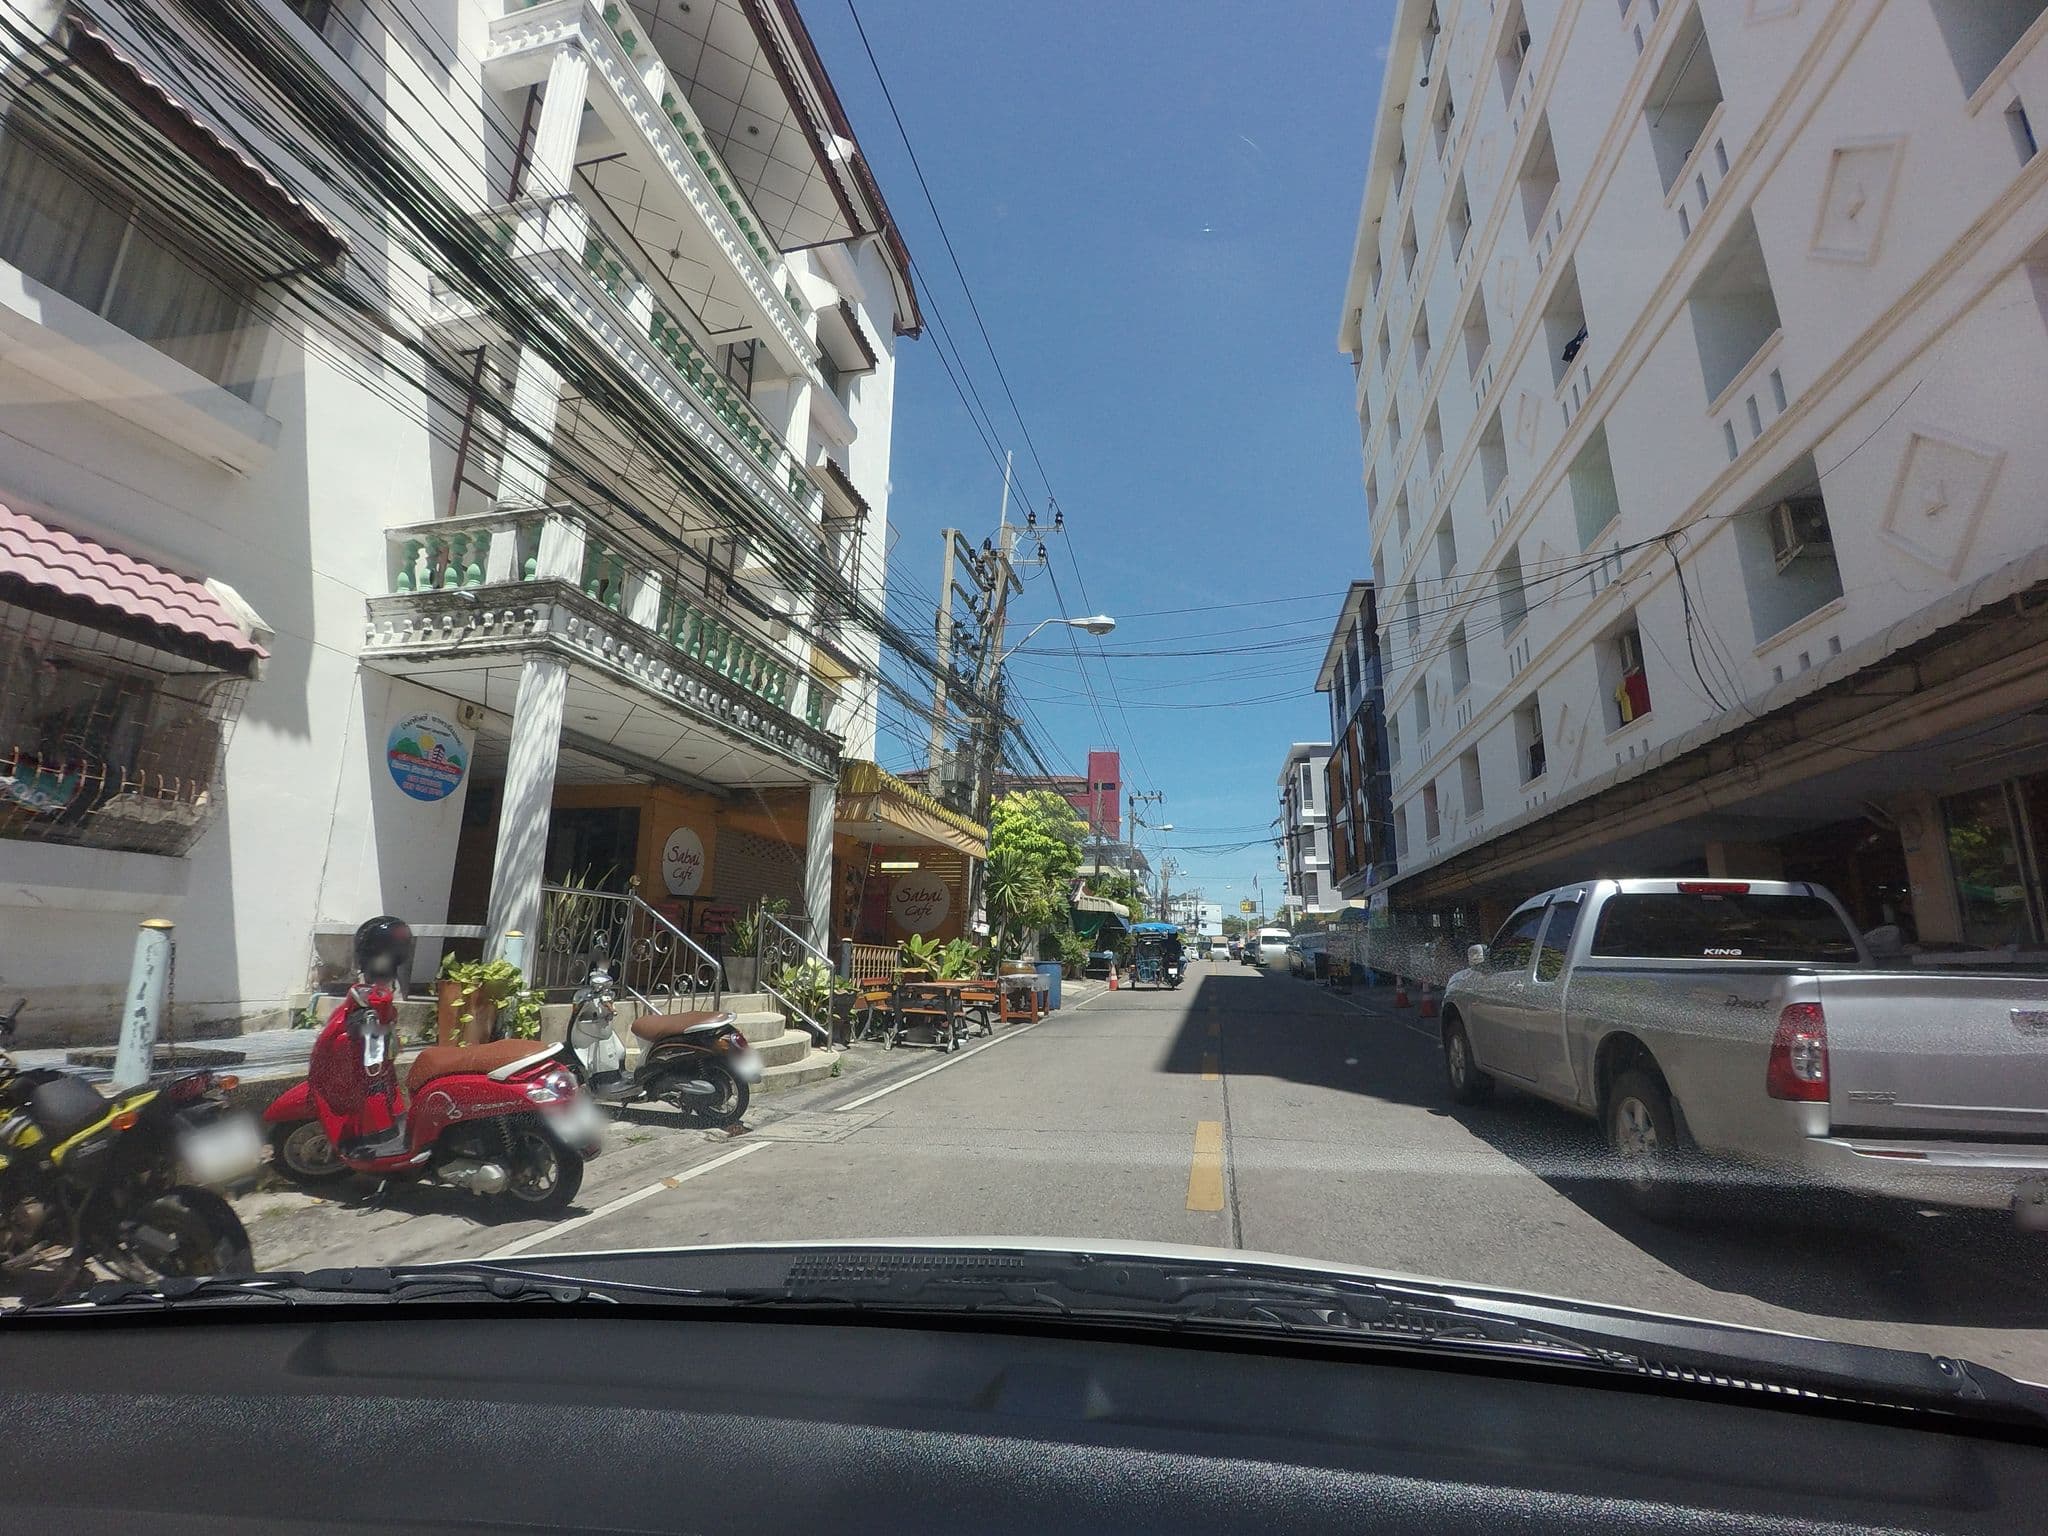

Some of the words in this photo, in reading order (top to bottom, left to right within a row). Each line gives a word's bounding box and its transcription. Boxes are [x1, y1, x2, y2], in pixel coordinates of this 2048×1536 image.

[668, 845, 700, 866] Sabai
[896, 887, 943, 903] Sabai
[1703, 948, 1743, 956] KING
